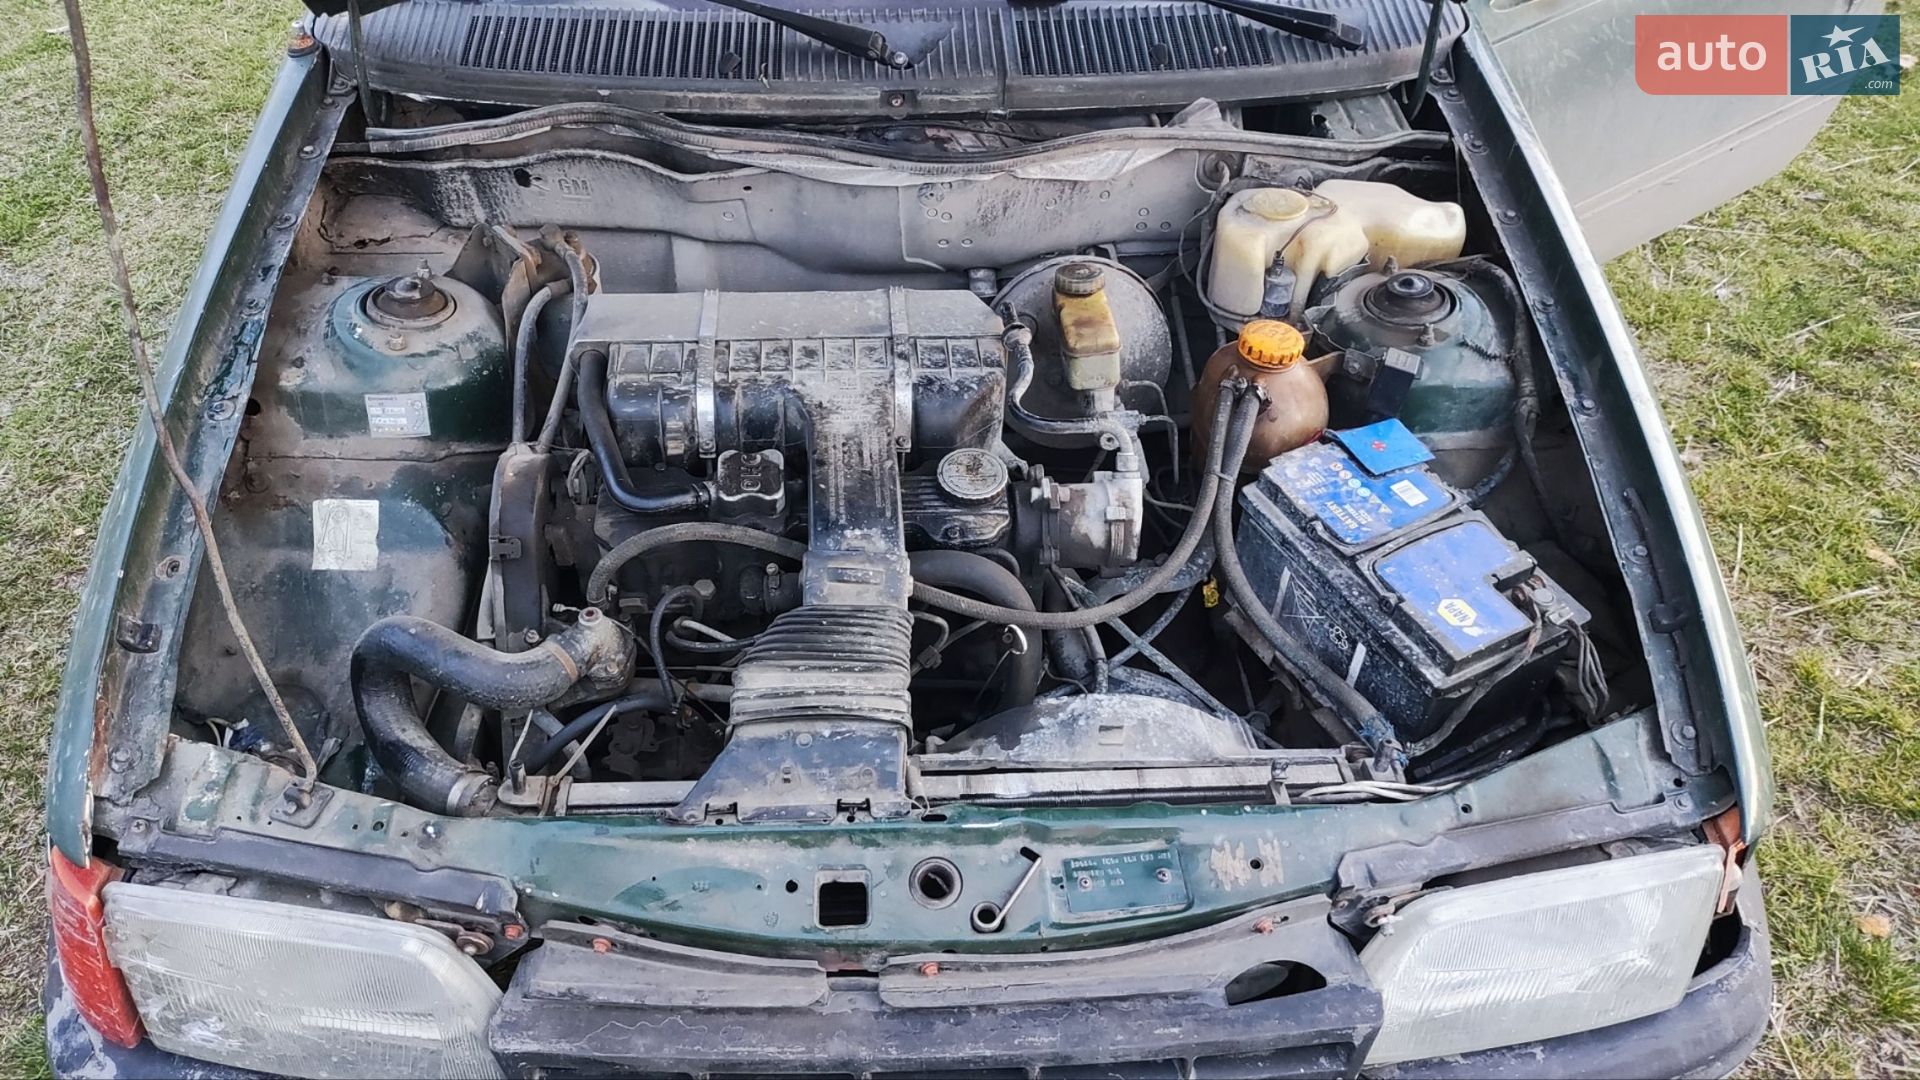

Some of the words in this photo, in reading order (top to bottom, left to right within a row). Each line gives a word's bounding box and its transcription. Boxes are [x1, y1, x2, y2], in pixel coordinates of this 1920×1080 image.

[557, 177, 592, 195] GM
[1325, 501, 1359, 530] BATTERY
[1443, 601, 1472, 623] NAPA
